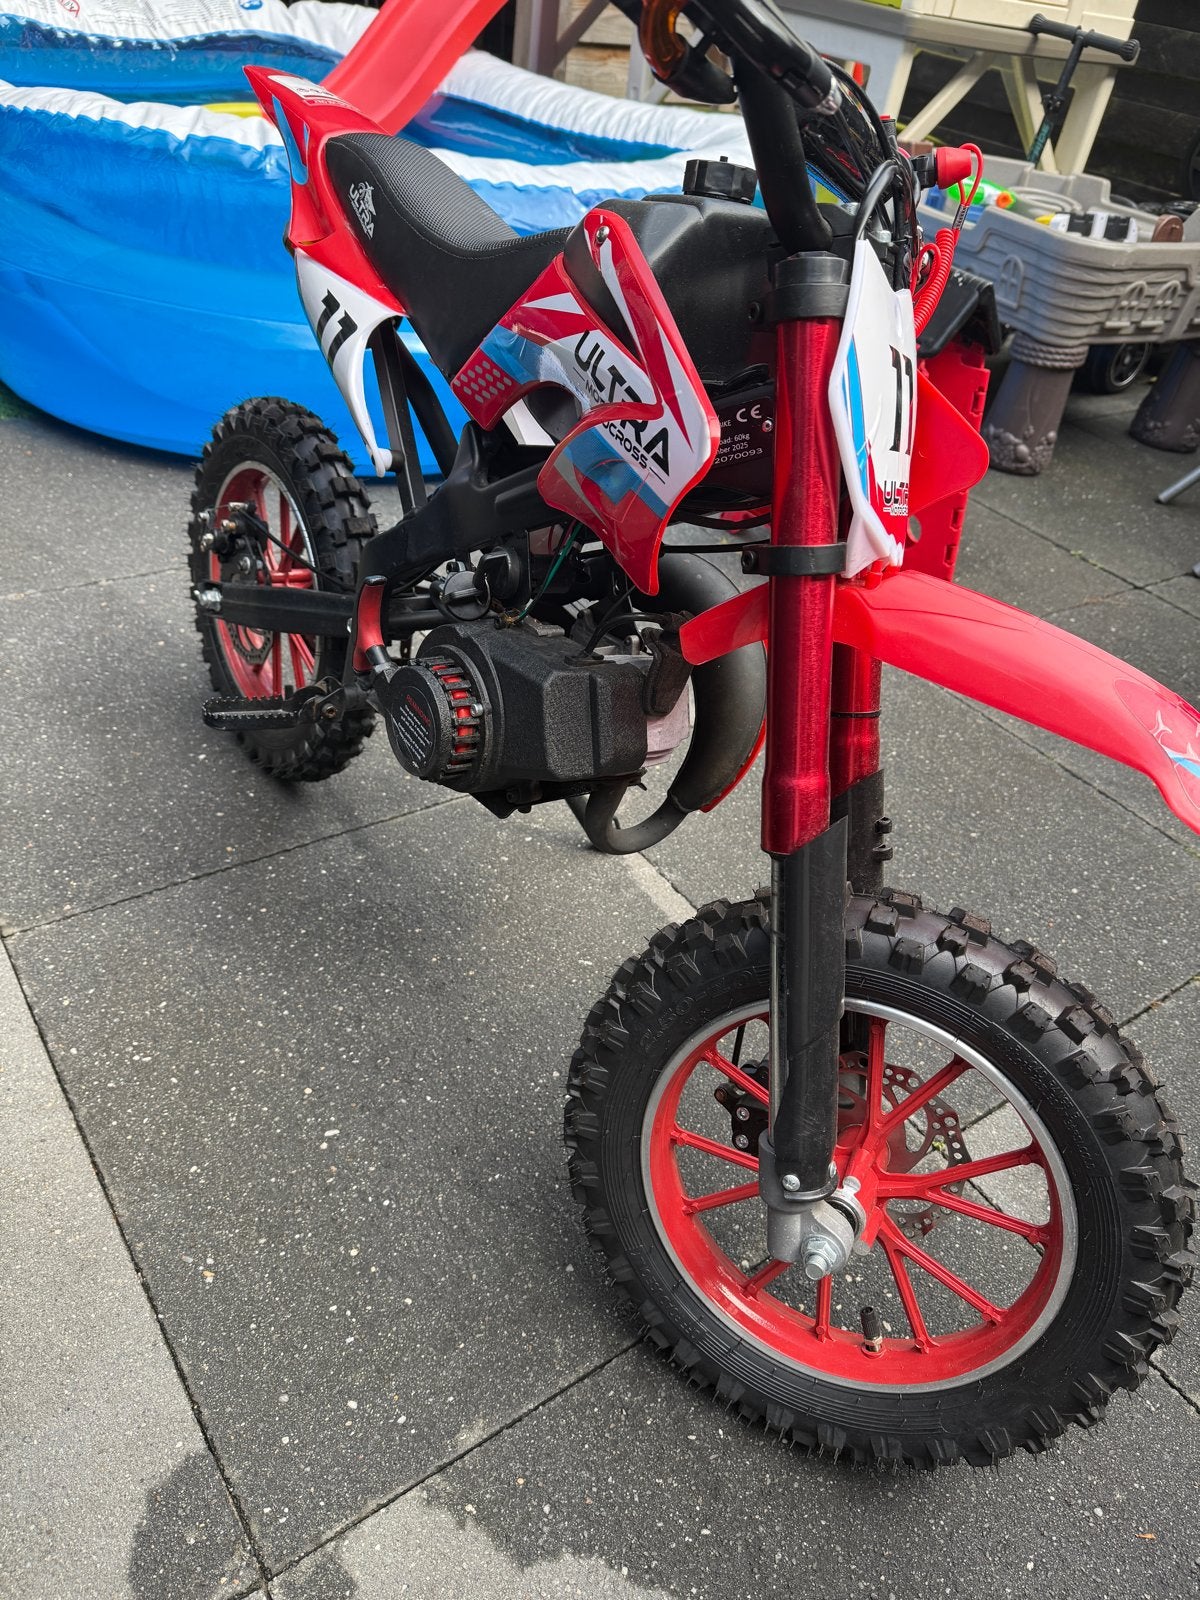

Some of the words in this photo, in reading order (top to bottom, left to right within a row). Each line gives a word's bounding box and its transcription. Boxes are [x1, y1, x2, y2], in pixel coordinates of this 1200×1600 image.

[350, 184, 376, 239] ULTRA
[317, 288, 358, 367] 11
[574, 329, 670, 477] ULTRA
[736, 404, 762, 422] CE
[889, 344, 914, 456] 11
[583, 377, 648, 469] MOCROSS
[719, 436, 733, 446] oad:
[734, 433, 750, 443] 60kg
[720, 419, 731, 428] IKE
[714, 447, 763, 464] 2070093
[732, 441, 748, 451] 2025
